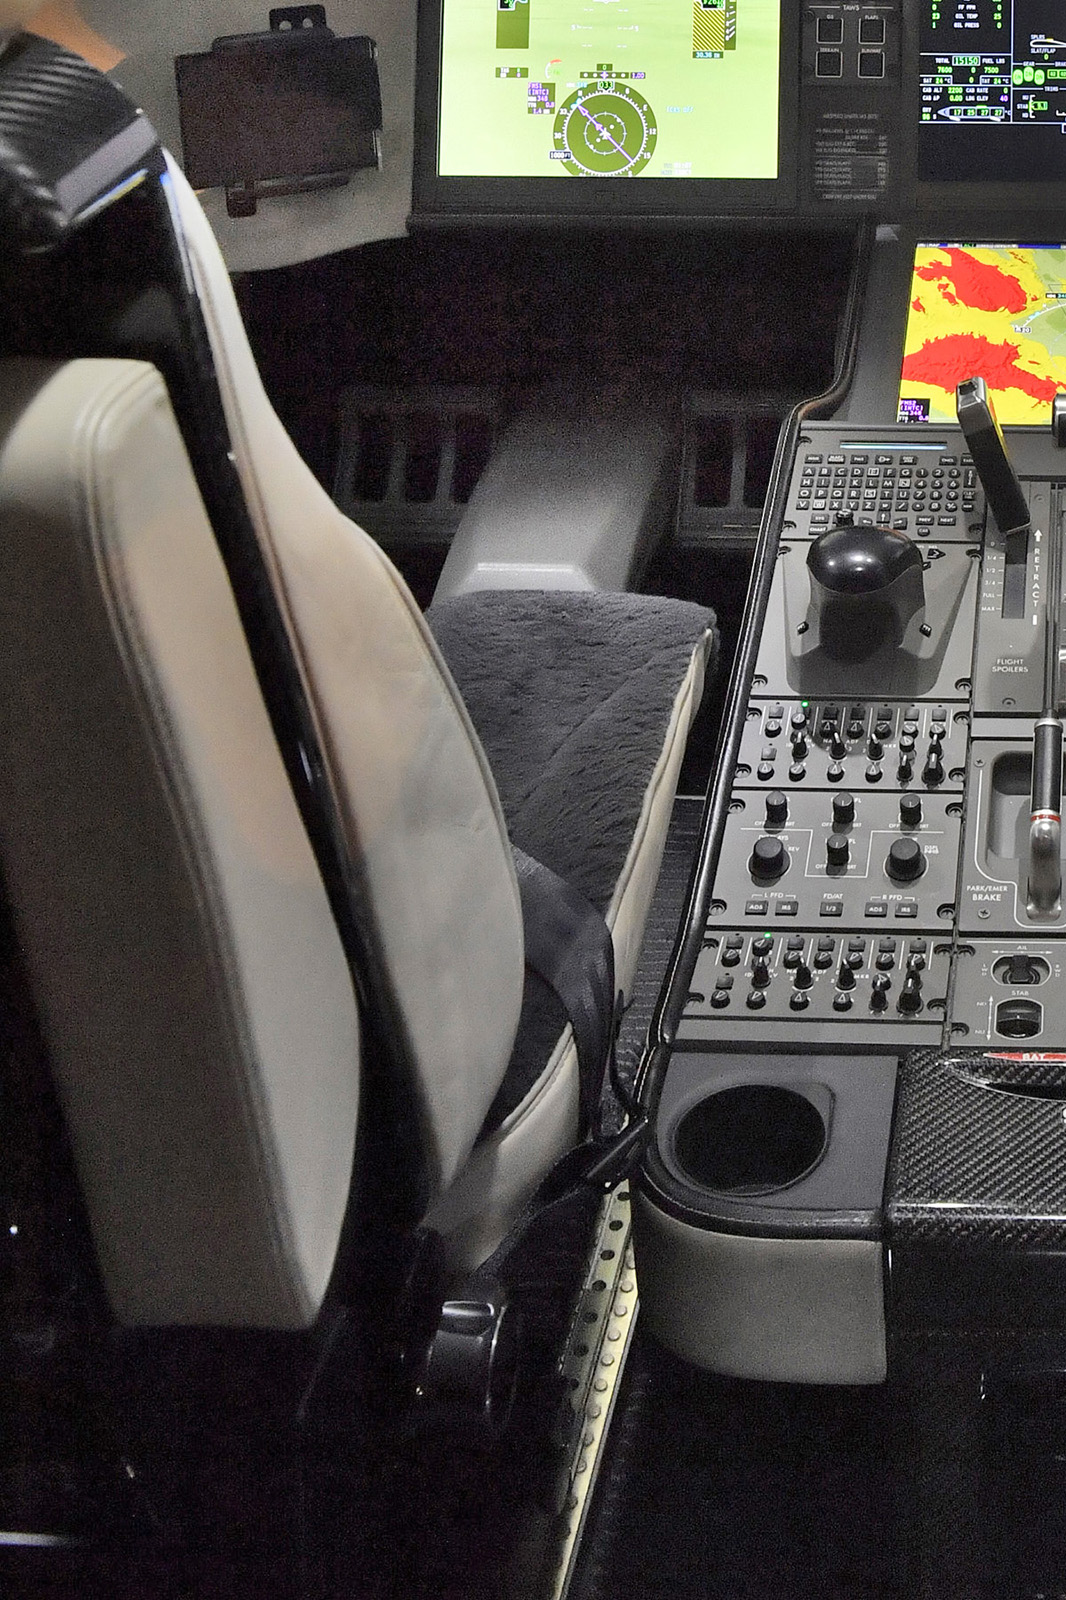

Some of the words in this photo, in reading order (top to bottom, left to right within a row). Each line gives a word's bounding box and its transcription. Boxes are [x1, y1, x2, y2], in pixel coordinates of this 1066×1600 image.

[997, 658, 1024, 666] FLIGHT
[992, 665, 1029, 674] SPOILERS
[966, 885, 1008, 893] PARK/EMER
[972, 894, 1002, 902] BRAKE
